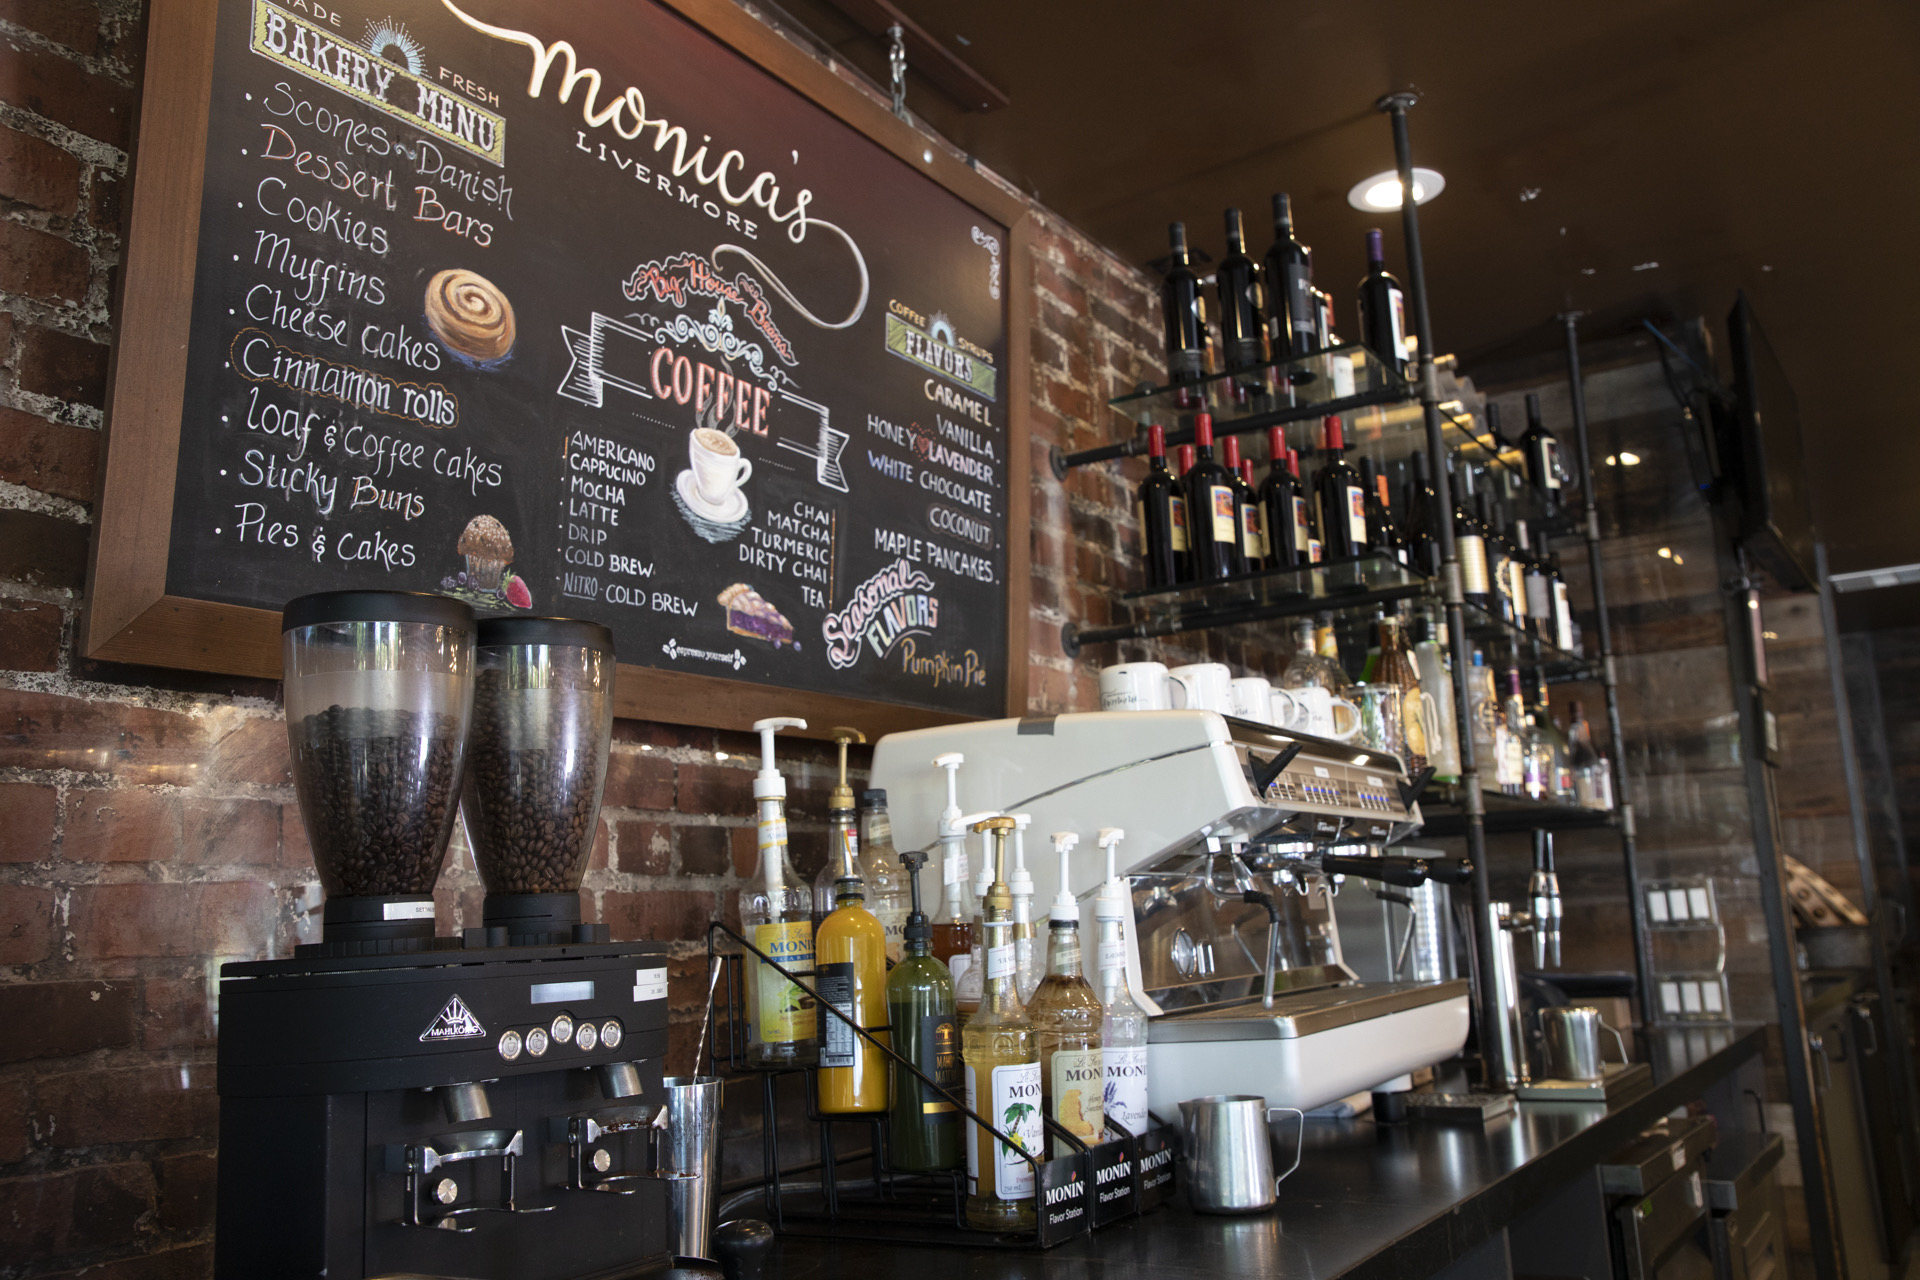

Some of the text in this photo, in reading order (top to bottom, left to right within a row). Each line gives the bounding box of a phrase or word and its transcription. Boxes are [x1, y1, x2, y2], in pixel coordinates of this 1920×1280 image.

[285, 0, 341, 27] ADE
[264, 8, 497, 152] BAKERY MENU
[439, 66, 500, 108] FRESH
[263, 82, 513, 221] Scones Danish
[260, 124, 494, 248] Dessert Bars
[576, 130, 759, 241] LIVERMORE
[257, 176, 390, 255] Cookies
[253, 230, 386, 306] Muffins
[245, 284, 348, 347] Cheese
[648, 258, 791, 360] Big House Beans
[888, 299, 927, 328] COFFEE
[905, 329, 973, 383] FLAVORS
[242, 338, 456, 426] Cinnamon rolls
[650, 347, 771, 437] COFFEE
[923, 378, 993, 427] CARAMEL
[344, 425, 424, 478] Coffee
[570, 430, 656, 473] AMERICANO
[867, 413, 993, 486] HONEY LAVENDER
[936, 413, 995, 460] VANILLA
[238, 449, 425, 520] Sticky Buns
[569, 453, 646, 486] CAPPUCINO
[570, 476, 626, 506] MOCHA
[867, 449, 992, 514] WHITE CHOCOLATE
[234, 502, 299, 548] Pies
[312, 526, 327, 563] &
[568, 523, 608, 546] DRIP
[569, 498, 619, 526] LATTE
[767, 510, 831, 545] MATCHA
[793, 501, 830, 525] CHAI
[929, 506, 992, 545] COCONUT
[564, 546, 654, 578] COLD BREW
[738, 543, 828, 584] DIRTY CHAI
[750, 526, 830, 565] TURMERIC
[874, 527, 994, 584] MAPLE PANCAKES
[651, 592, 698, 617] BREW
[801, 585, 825, 609] TEA
[824, 558, 918, 664] Seasonal
[866, 594, 939, 659] FLAVORS
[900, 637, 987, 688] Pumpkin Pie
[1096, 1161, 1131, 1186] MONIN
[1139, 1148, 1172, 1174] MONIN
[1143, 1172, 1172, 1190] Flavor Station
[1045, 1180, 1084, 1206] MONIN
[1049, 1206, 1083, 1225] Flavor Station
[1099, 1185, 1131, 1204] Flavor Station
